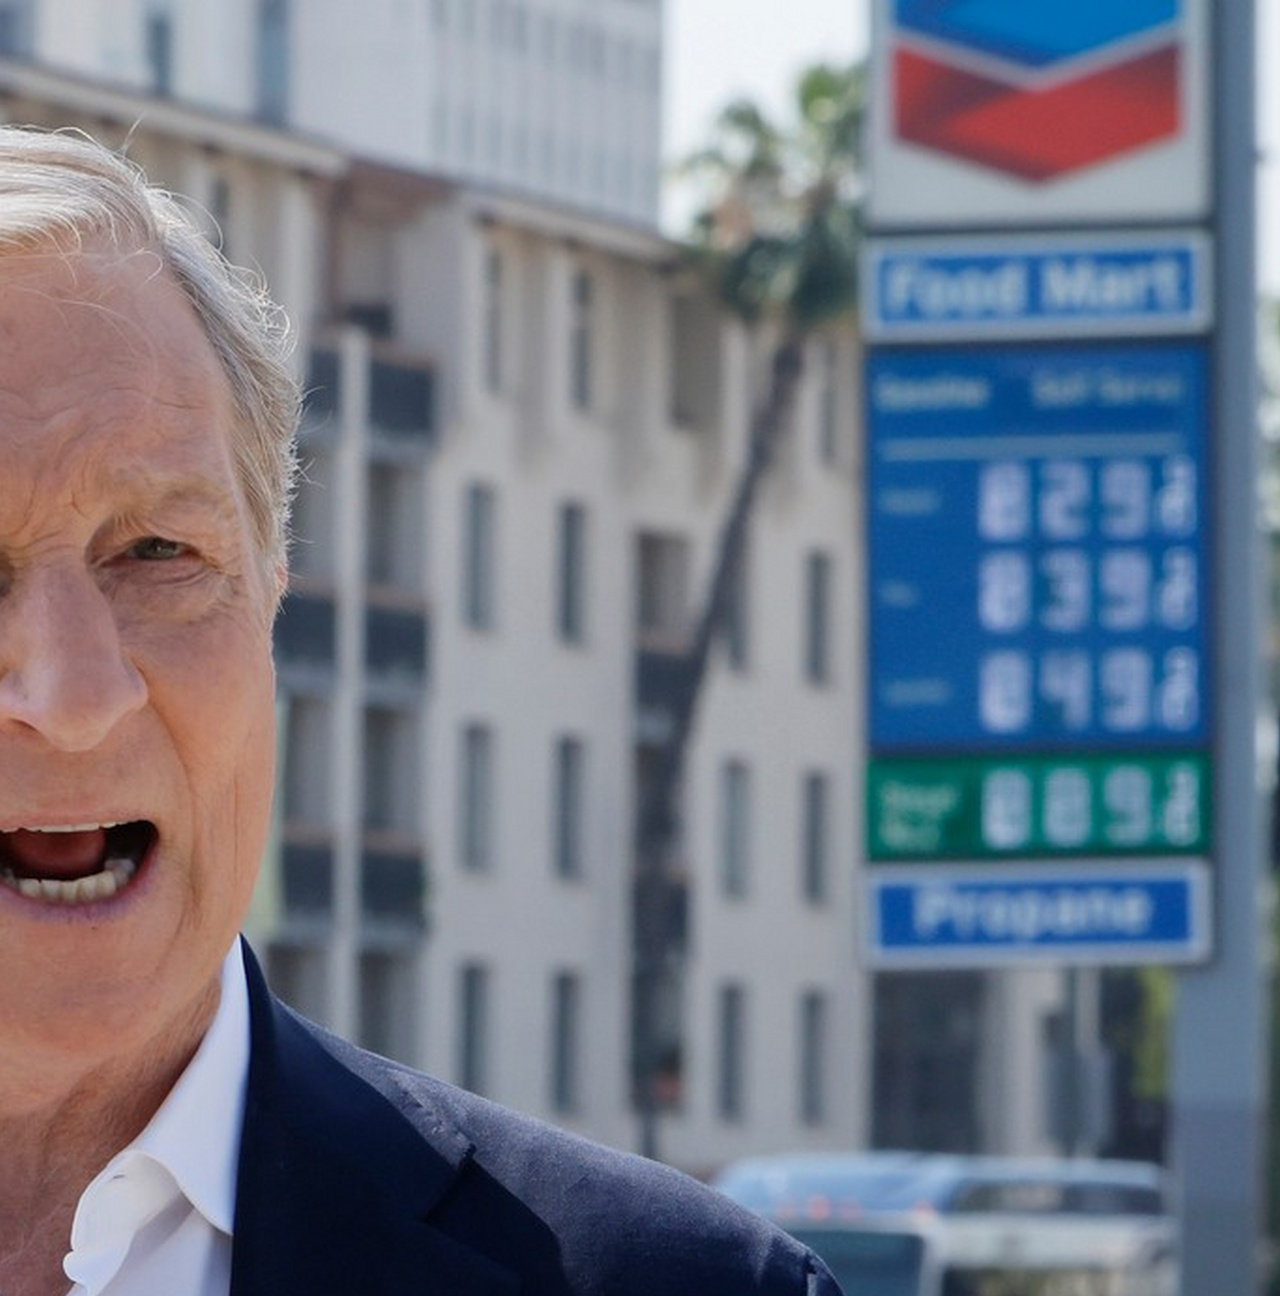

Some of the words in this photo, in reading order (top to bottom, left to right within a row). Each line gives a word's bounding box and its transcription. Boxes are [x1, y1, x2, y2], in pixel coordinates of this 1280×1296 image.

[887, 258, 1027, 314] Food
[1041, 255, 1177, 308] Mart
[913, 887, 1150, 940] Propane
